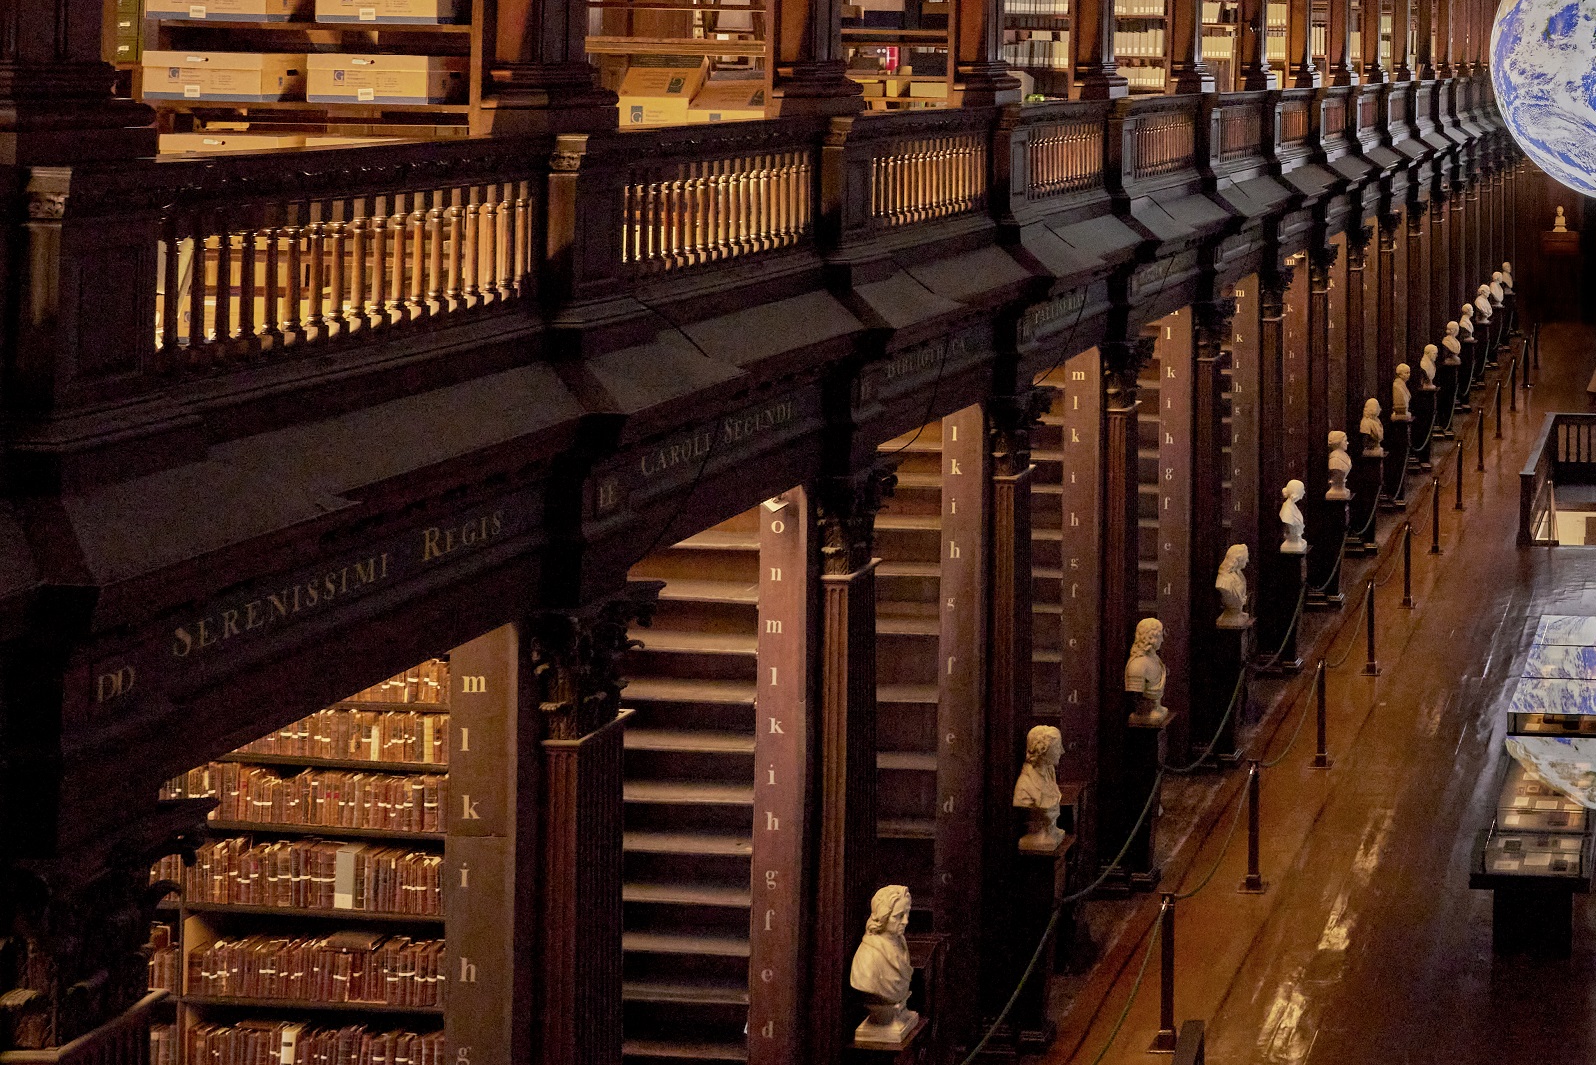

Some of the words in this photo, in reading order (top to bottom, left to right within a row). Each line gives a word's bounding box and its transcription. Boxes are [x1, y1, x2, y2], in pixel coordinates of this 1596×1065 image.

[1166, 366, 1176, 379] k
[1071, 428, 1080, 443] k
[641, 432, 711, 477] CAROLI
[950, 458, 962, 475] k
[1165, 467, 1174, 481] g
[951, 497, 957, 515] i
[771, 520, 785, 534] o
[1070, 512, 1079, 527] h
[950, 541, 961, 559] h
[1070, 557, 1079, 570] g
[770, 567, 782, 581] n
[171, 552, 390, 659] SERENISSIMI
[422, 509, 504, 563] REGIS
[1163, 582, 1172, 595] d
[947, 597, 956, 612] g
[766, 619, 783, 634] m
[947, 656, 956, 675] f
[98, 665, 136, 703] DD
[462, 675, 487, 692] m
[770, 667, 778, 686] l
[1068, 689, 1078, 704] d
[769, 717, 784, 734] k
[459, 728, 470, 751] l
[767, 764, 777, 785] i
[461, 795, 481, 819] k
[943, 796, 955, 814] d
[766, 811, 779, 831] h
[459, 862, 470, 887] i
[765, 869, 778, 889] g
[764, 909, 775, 931] f
[459, 957, 477, 982] h
[761, 968, 773, 982] e
[762, 1021, 774, 1038] d
[456, 1045, 472, 1065] g
